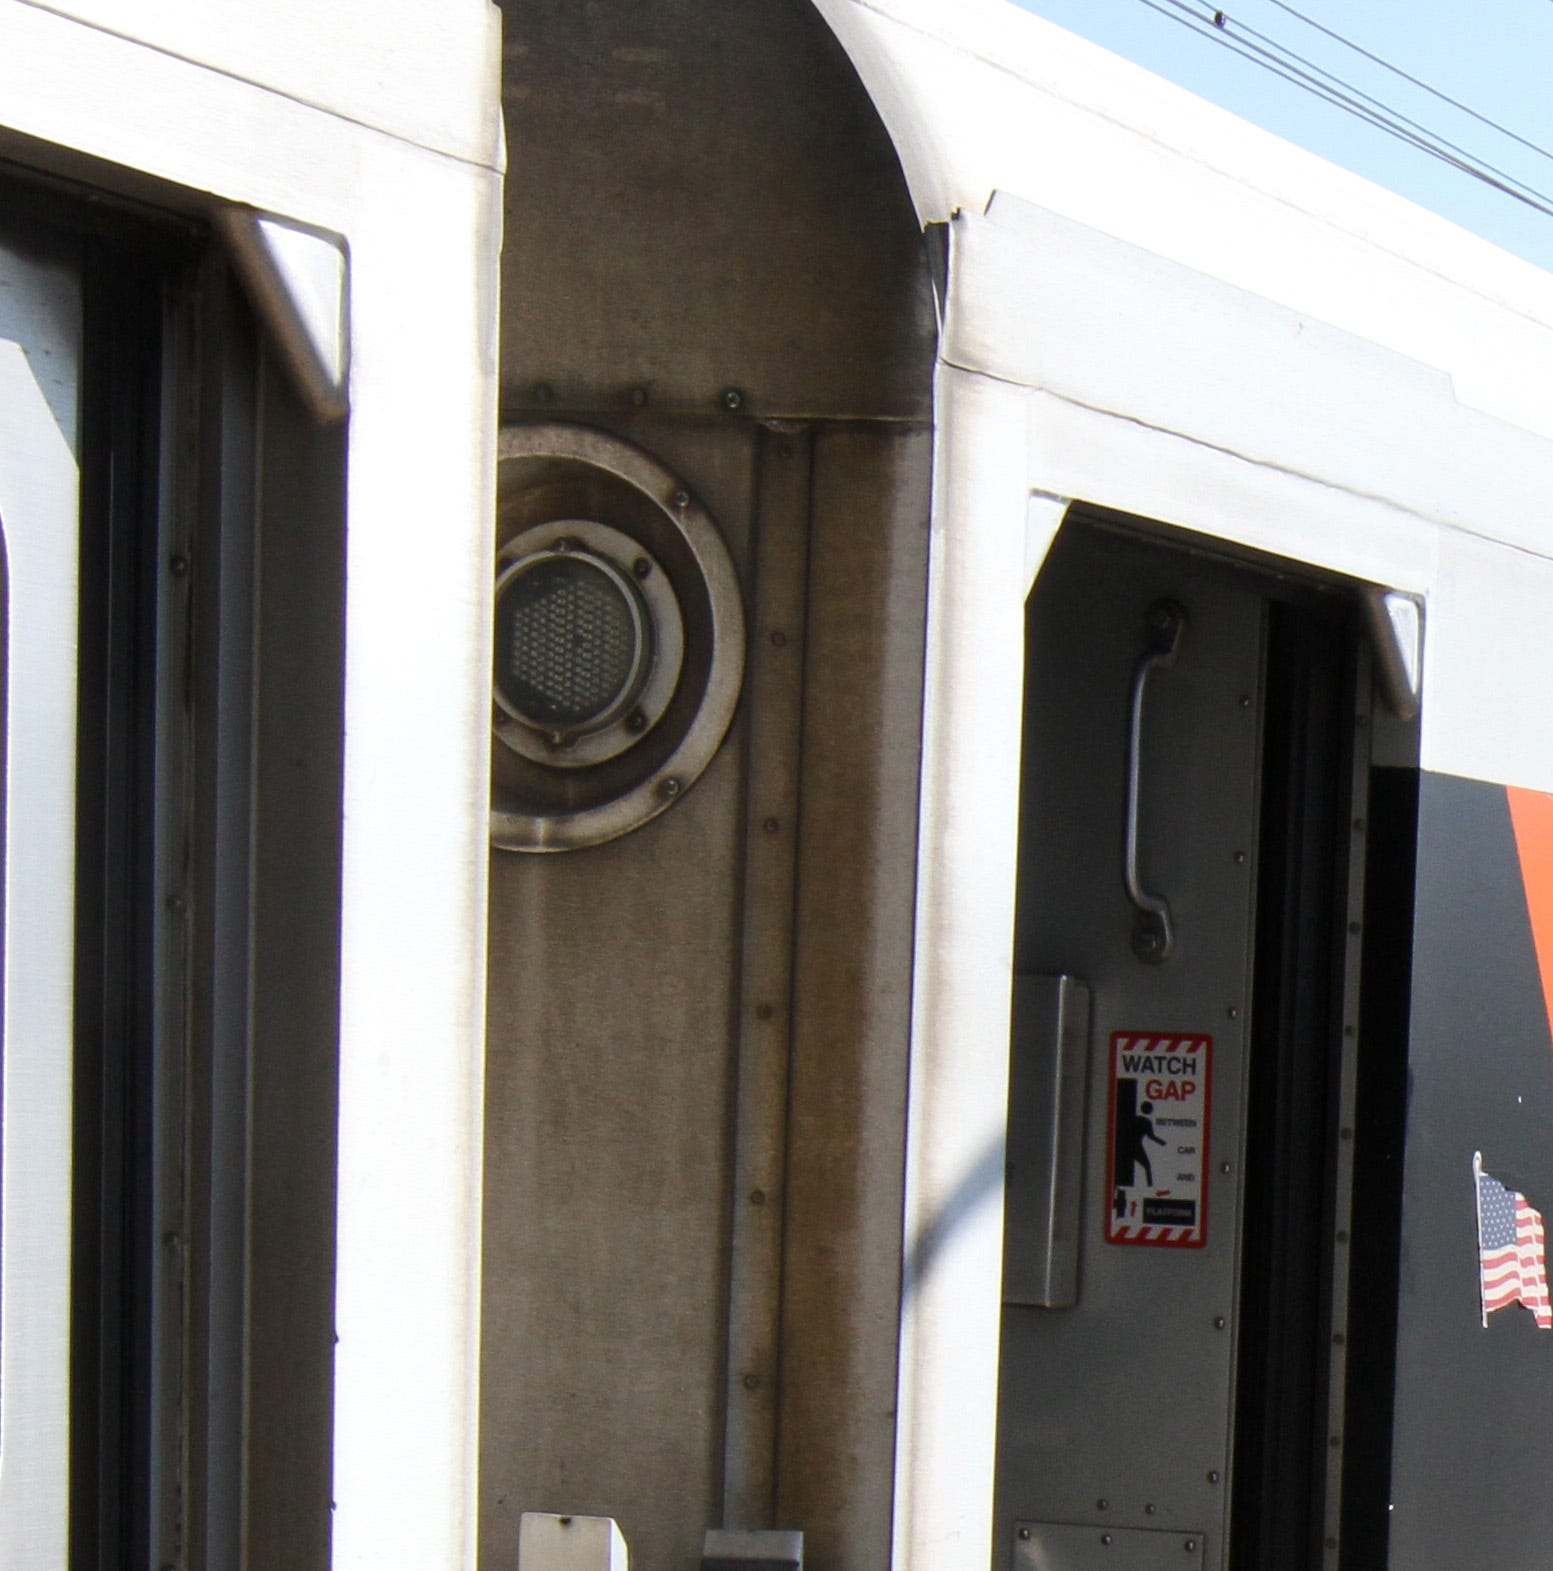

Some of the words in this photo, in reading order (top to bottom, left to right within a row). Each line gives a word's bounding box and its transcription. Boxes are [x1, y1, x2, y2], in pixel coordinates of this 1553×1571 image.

[1122, 1055, 1197, 1076] WATCH
[1145, 1079, 1196, 1101] GAP
[1155, 1117, 1197, 1128] BETWEEN
[1177, 1146, 1196, 1155] CAR
[1176, 1173, 1195, 1182] AND
[1146, 1207, 1193, 1218] PLATFORM
